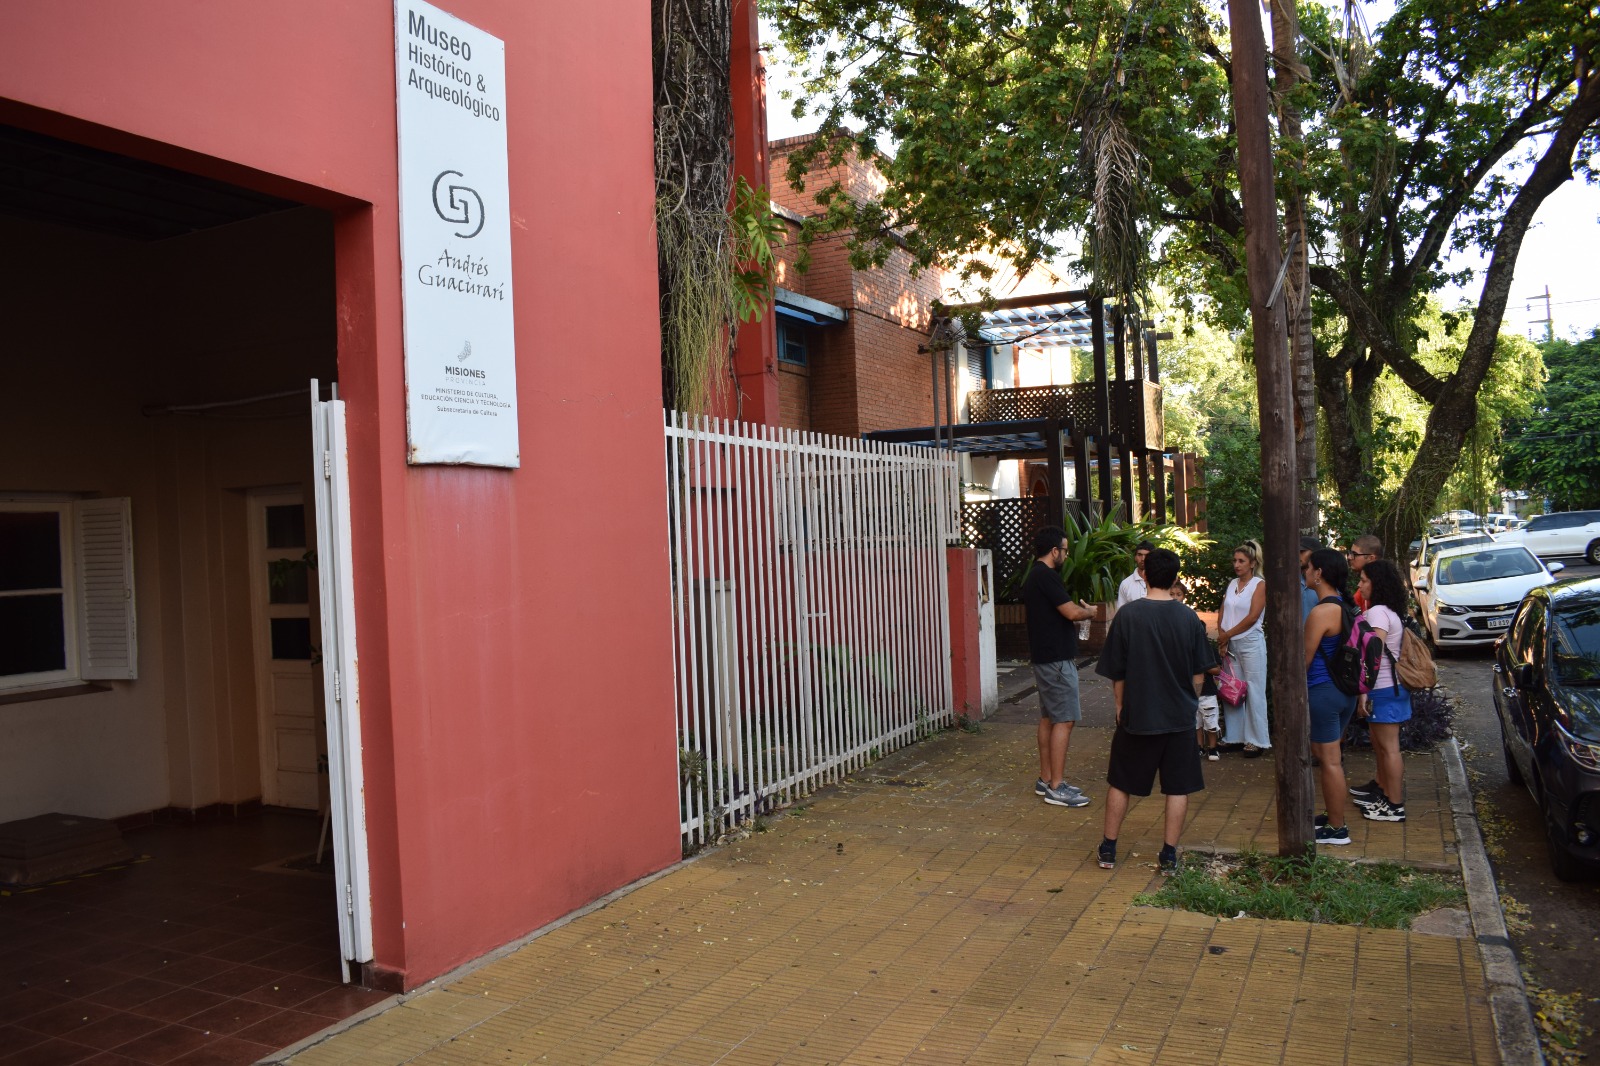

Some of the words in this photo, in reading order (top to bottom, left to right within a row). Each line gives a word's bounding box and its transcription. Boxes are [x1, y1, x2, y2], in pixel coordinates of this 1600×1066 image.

[408, 9, 471, 61] Museo
[408, 42, 471, 87] Histórico
[476, 74, 486, 93] &
[408, 68, 500, 122] Arqueológico
[437, 249, 489, 280] Andrés
[418, 264, 504, 301] Guacurarí
[445, 366, 486, 379] MISIONES
[445, 377, 486, 386] PROVINCIA
[435, 387, 465, 396] MINISTERIO
[454, 396, 475, 404] CIENCIA
